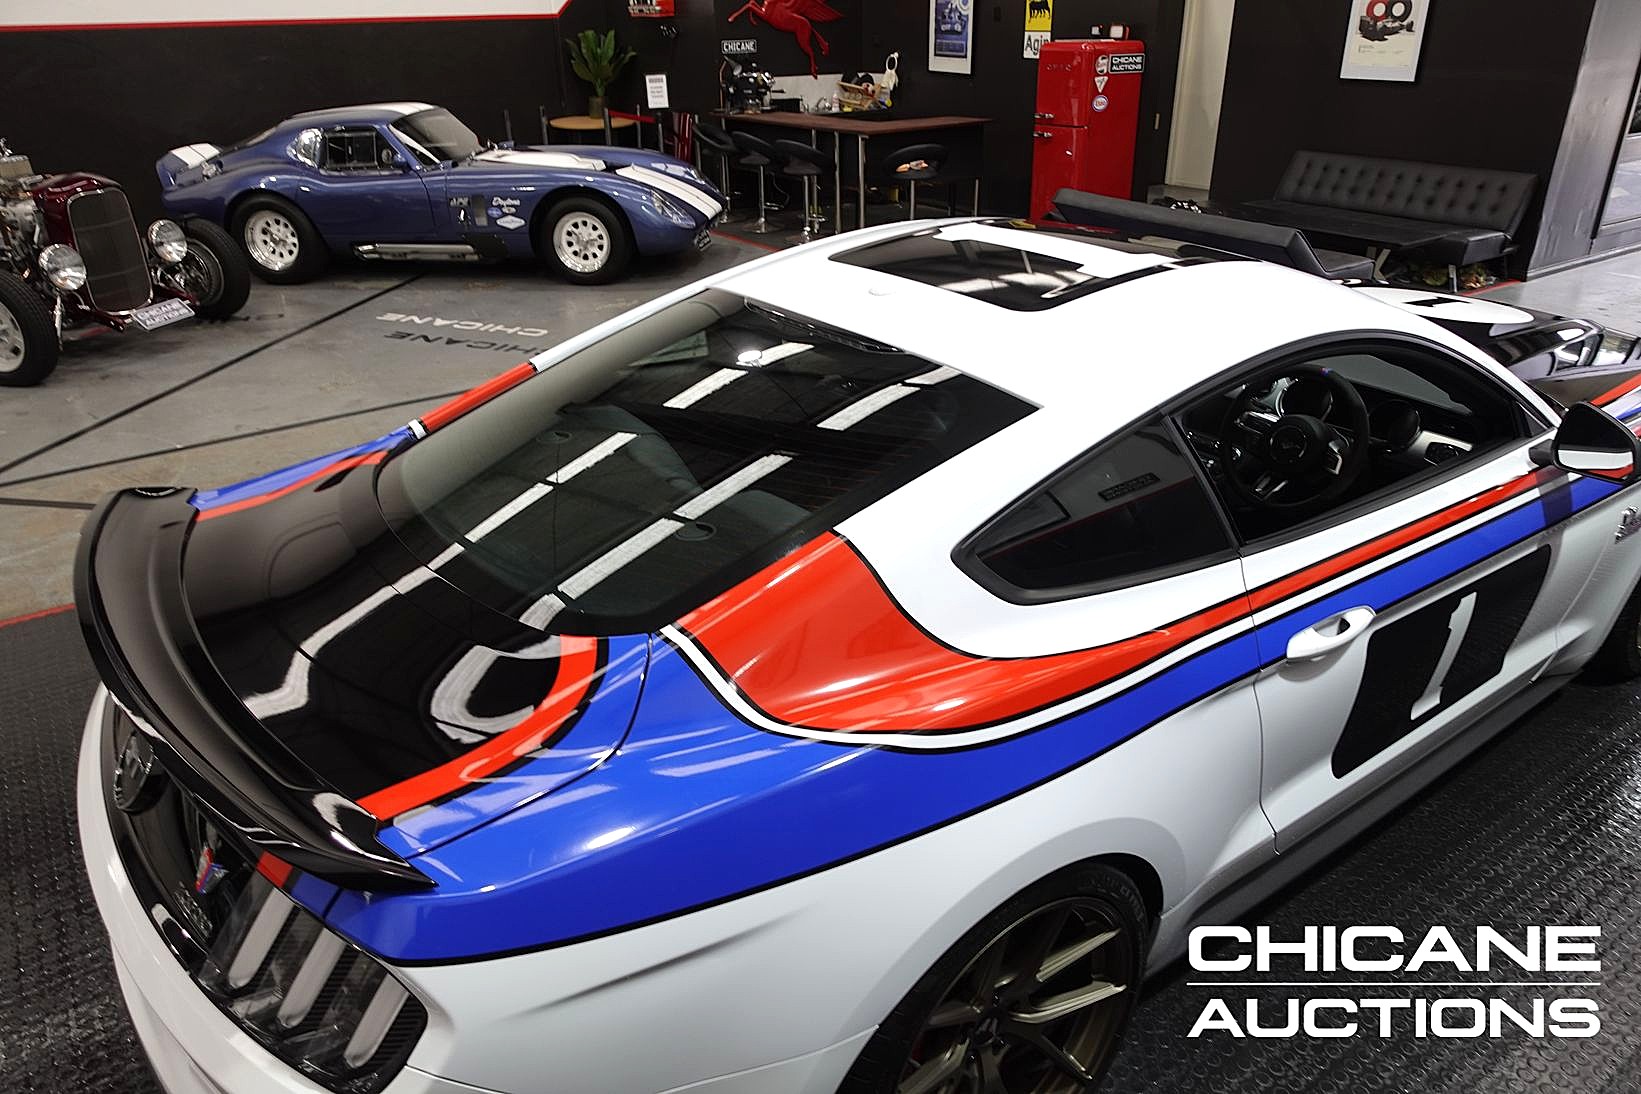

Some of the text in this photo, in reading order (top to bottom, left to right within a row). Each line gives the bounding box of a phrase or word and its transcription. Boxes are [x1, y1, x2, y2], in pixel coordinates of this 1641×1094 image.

[723, 42, 755, 52] CHICANE
[1111, 56, 1143, 64] CHICANE
[375, 312, 549, 337] CHICANE
[383, 331, 546, 355] HICANE
[1410, 591, 1478, 721] 1
